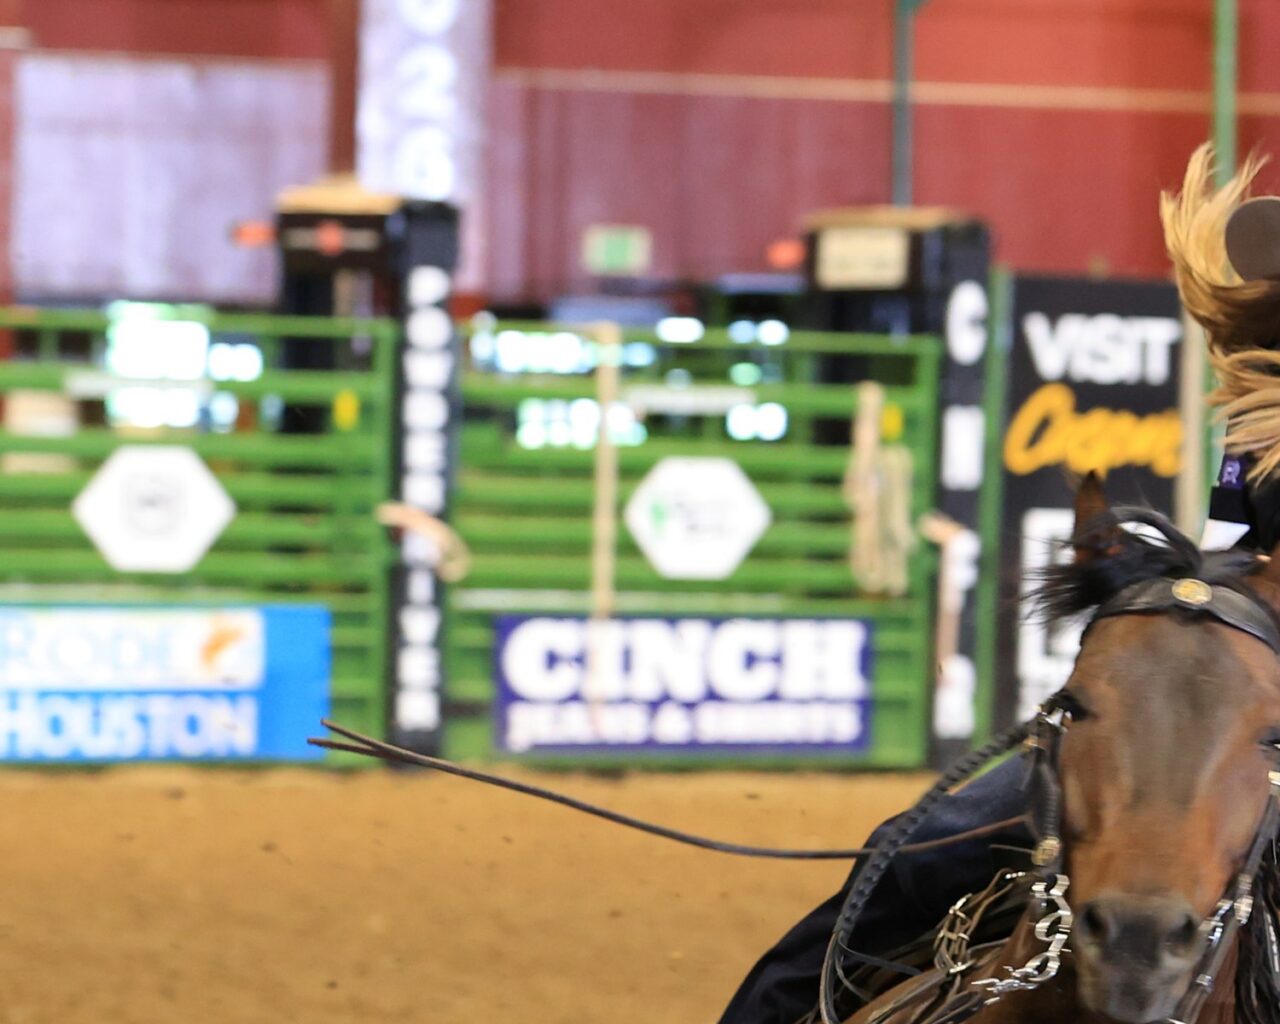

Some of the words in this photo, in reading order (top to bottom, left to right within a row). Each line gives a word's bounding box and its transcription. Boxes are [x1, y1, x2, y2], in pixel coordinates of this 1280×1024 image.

[1022, 312, 1182, 387] VISIT
[505, 620, 865, 701] CINCH
[0, 692, 258, 757] HOUSTON
